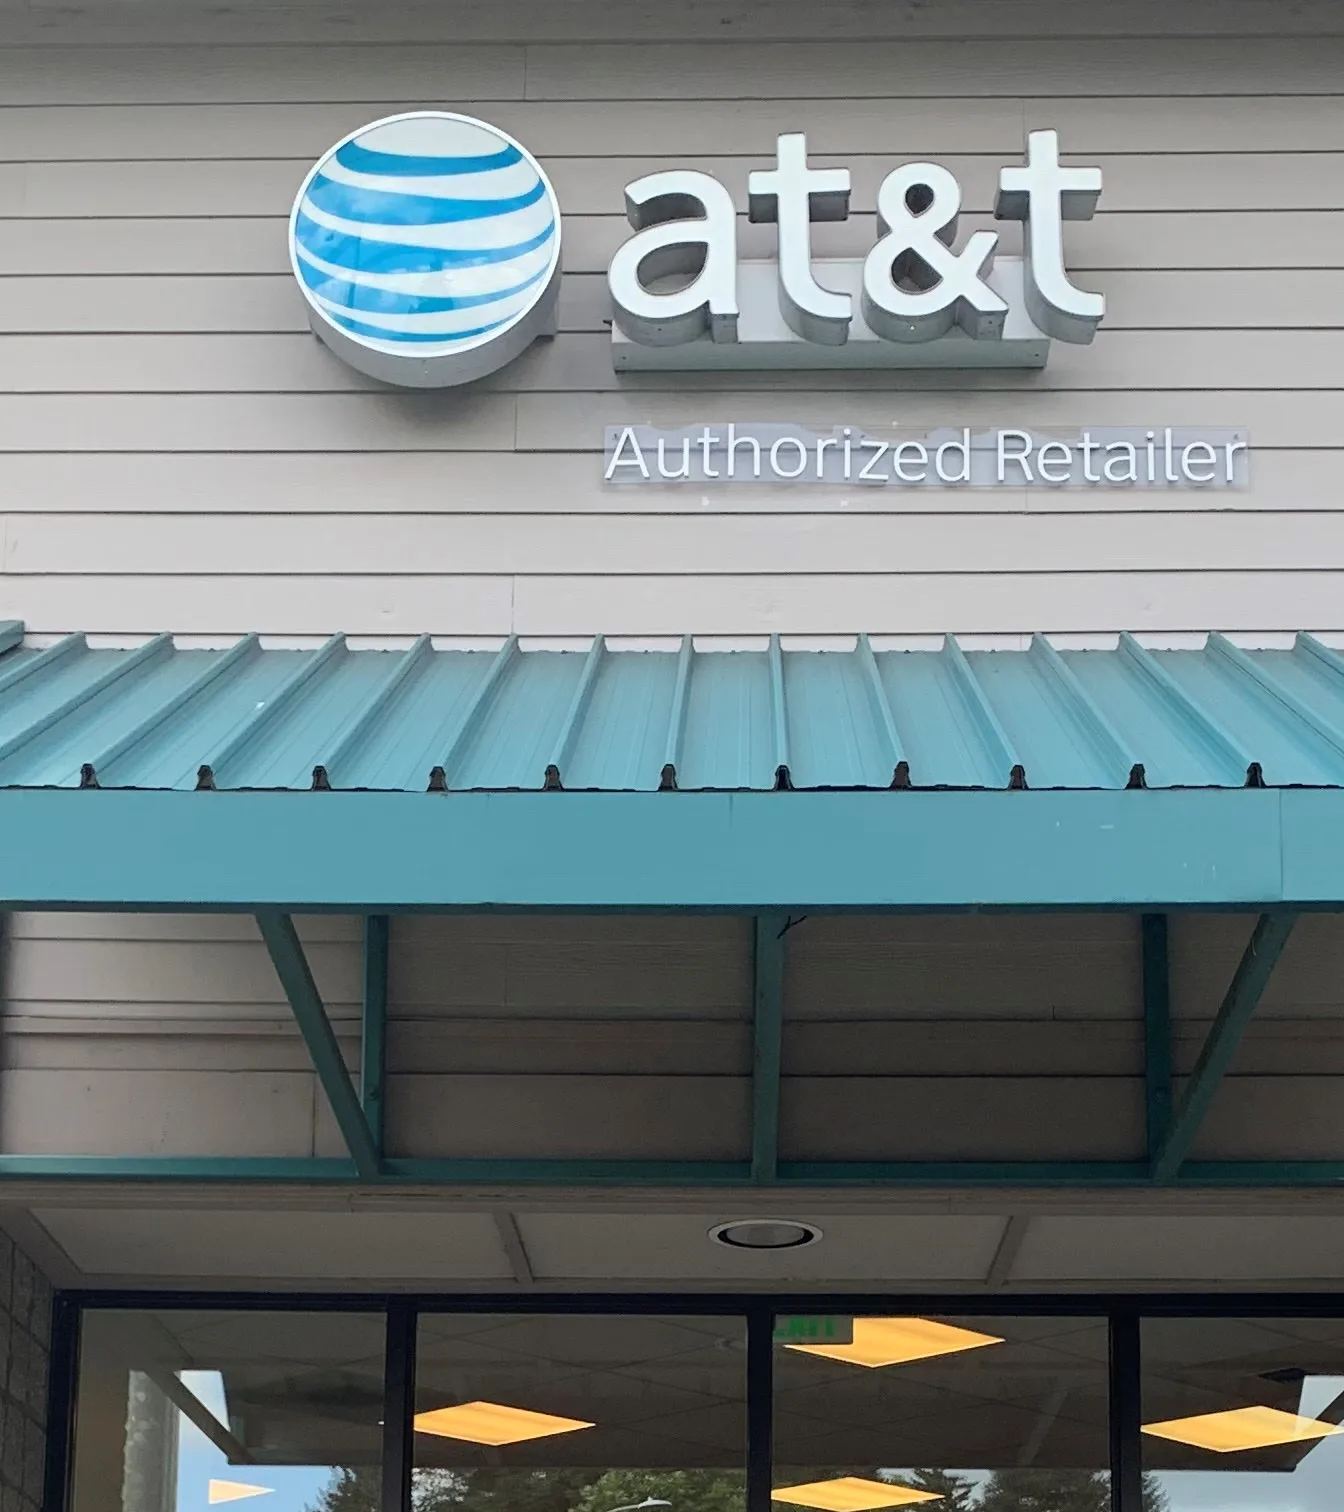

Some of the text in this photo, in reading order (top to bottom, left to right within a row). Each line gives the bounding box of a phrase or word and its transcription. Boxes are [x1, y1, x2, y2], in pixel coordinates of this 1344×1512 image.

[606, 128, 1106, 345] at&t
[605, 422, 1248, 484] Authorized Retailer
